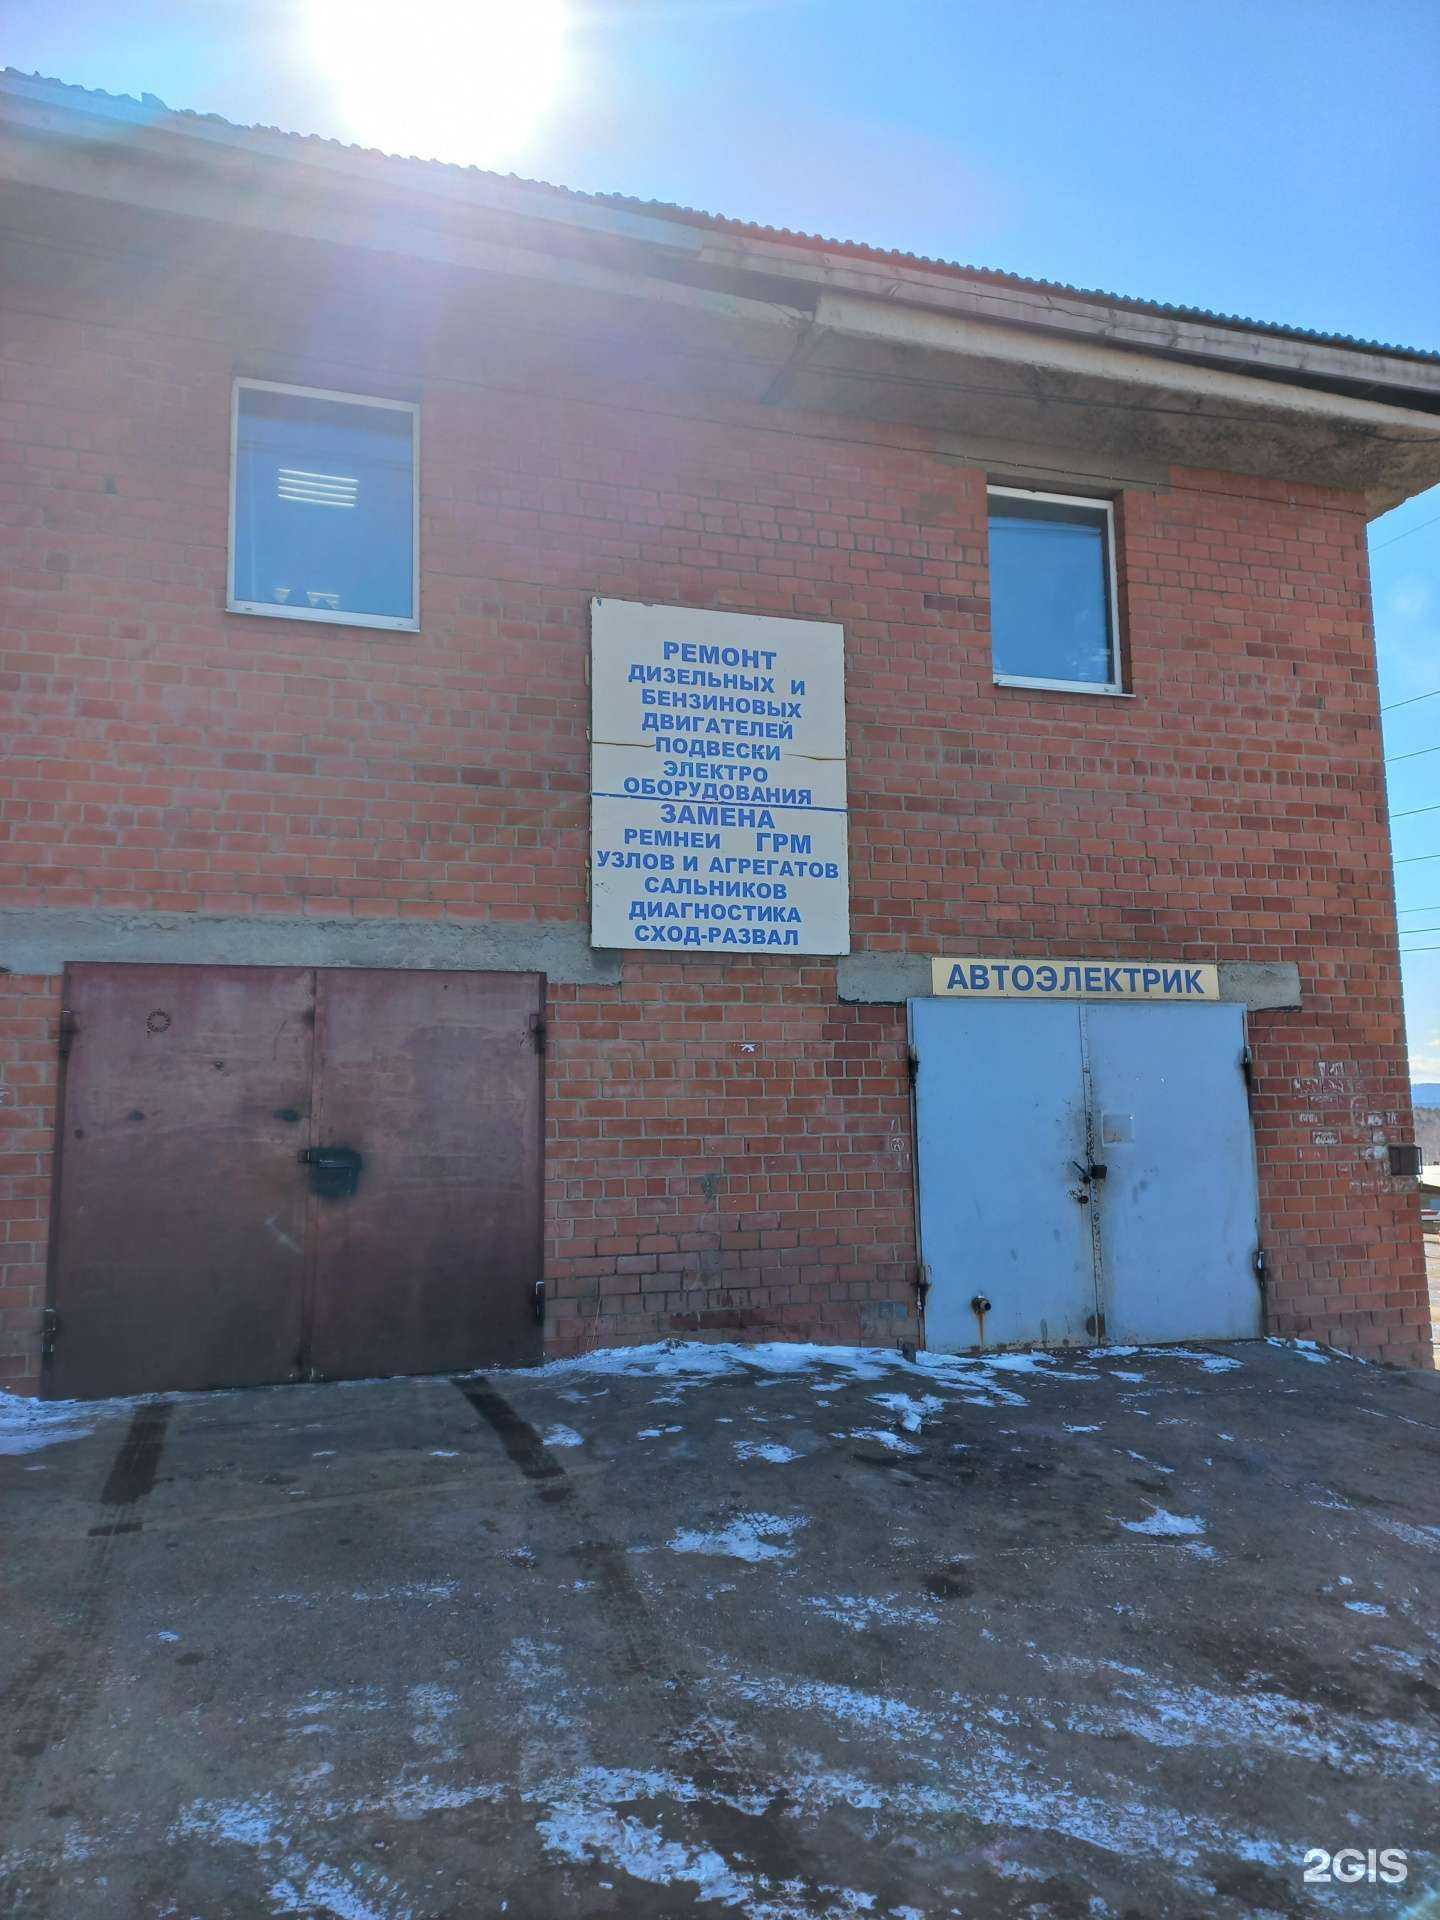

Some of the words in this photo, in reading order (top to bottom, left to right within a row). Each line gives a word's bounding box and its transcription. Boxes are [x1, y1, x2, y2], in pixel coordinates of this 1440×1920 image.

[664, 641, 776, 669] РЕМОНТ
[628, 664, 775, 693] ДИЗЕЛЬНЫХ
[791, 680, 805, 696] И
[642, 689, 801, 718] БЕНЗИНОВЫХ
[642, 712, 793, 740] ДВИГАТЕЛЕЙ
[655, 737, 780, 761] ПОДВЕСКИ
[663, 761, 768, 783] ЭЛЕКТРО
[624, 777, 812, 805] ОБОРУДОВАНИЯ
[661, 804, 775, 828] ЗАМЕНА
[756, 832, 811, 854] ГРМ
[597, 850, 674, 870] УЗЛОВ
[683, 856, 698, 871] И
[709, 857, 838, 878] АГРЕГАТОВ
[645, 876, 787, 899] САЛЬНИКОВ
[629, 901, 801, 923] ДИАГНОСТИКА
[635, 925, 799, 945] СХОД-РАЗВАЛ
[947, 964, 1204, 993] АВТОЭЛЕКТРИК
